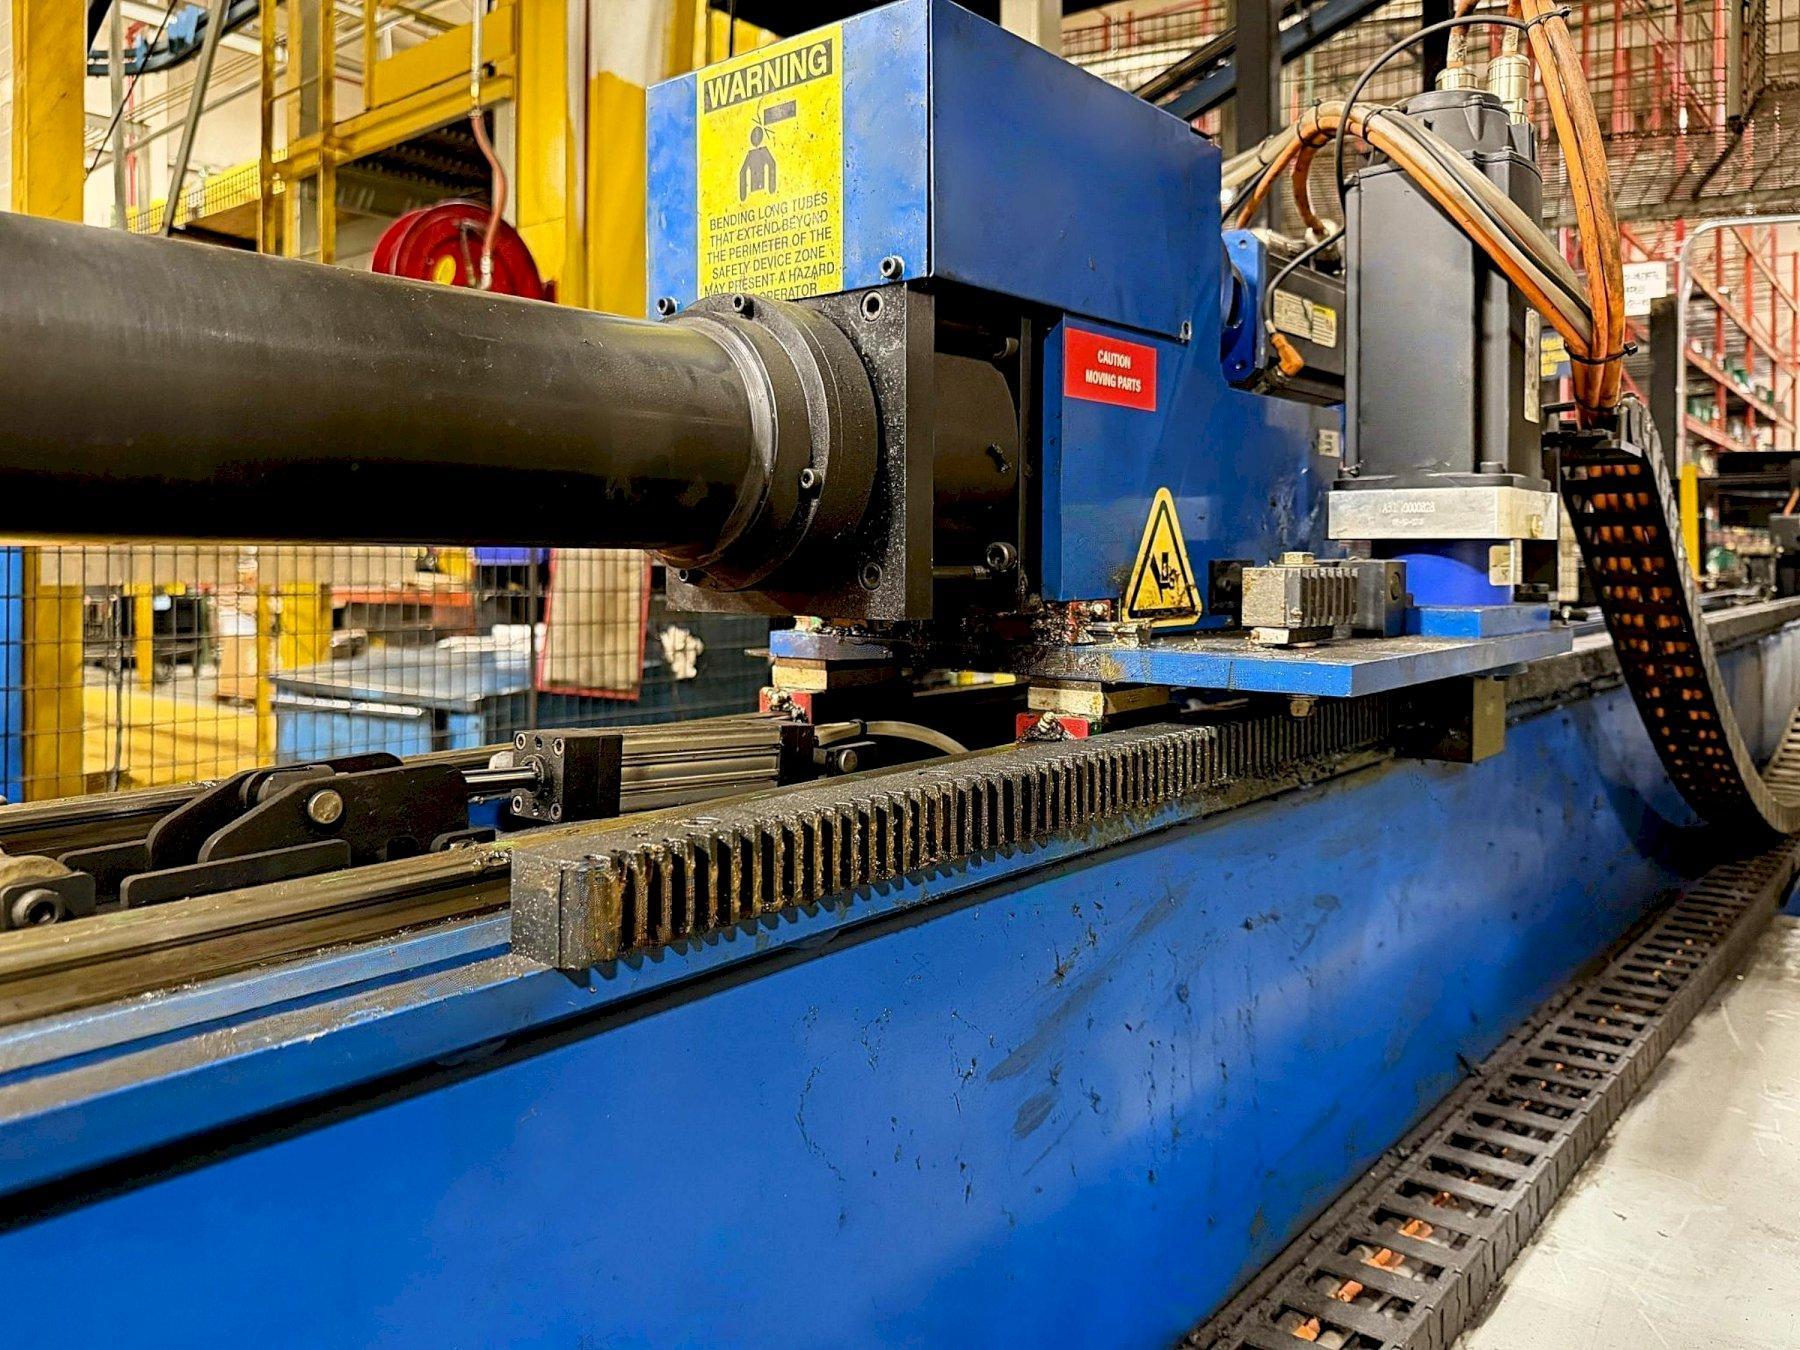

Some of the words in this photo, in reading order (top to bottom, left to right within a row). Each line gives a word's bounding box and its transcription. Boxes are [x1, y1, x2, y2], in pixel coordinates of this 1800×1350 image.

[708, 44, 827, 108] WARNING
[710, 210, 755, 230] BENDING
[758, 202, 788, 219] LONG
[793, 191, 828, 211] TUBES
[710, 231, 735, 249] THAT
[737, 221, 780, 242] EXTEND
[782, 209, 829, 232] BEYOND
[707, 250, 727, 265] THE
[728, 235, 789, 259] PERIMETER
[792, 232, 808, 247] OF
[811, 226, 832, 242] THE
[712, 260, 751, 280] SAFETY
[753, 252, 792, 271] DEVICE
[795, 245, 826, 263] ZONE
[704, 282, 726, 298] MAY
[728, 272, 775, 292] PRESENT
[778, 271, 786, 285] A
[788, 261, 835, 283] HAZARD
[1098, 350, 1131, 369] CAUTION
[1086, 369, 1116, 387] MOVING
[1118, 376, 1141, 392] PARTS
